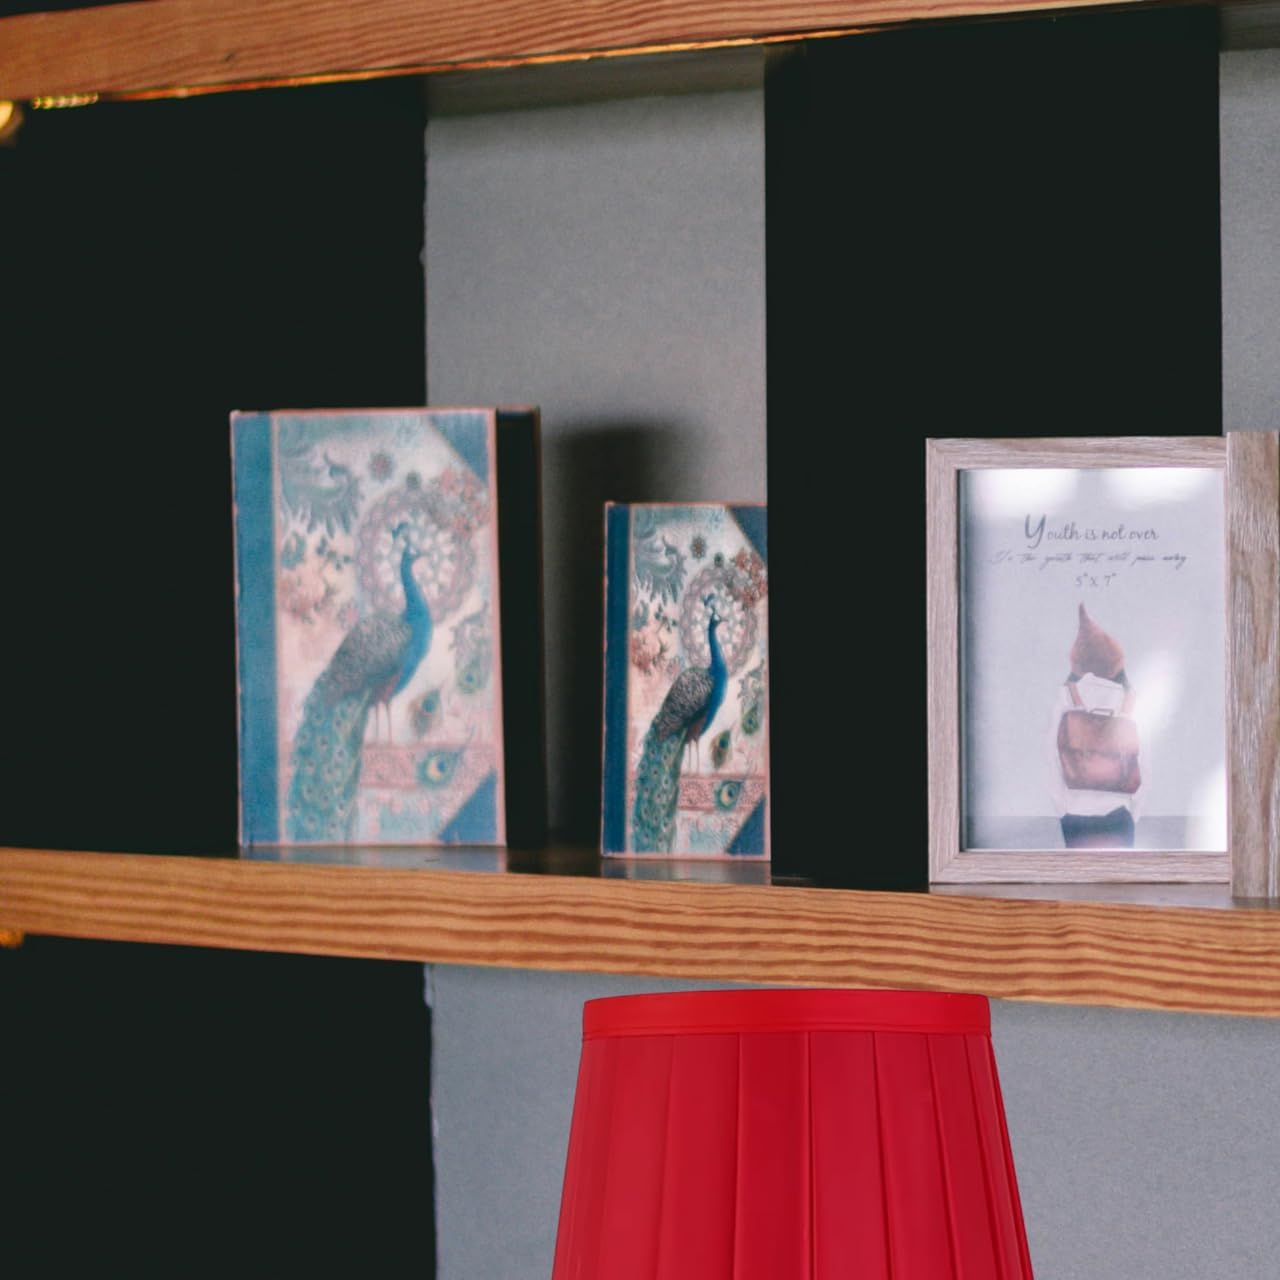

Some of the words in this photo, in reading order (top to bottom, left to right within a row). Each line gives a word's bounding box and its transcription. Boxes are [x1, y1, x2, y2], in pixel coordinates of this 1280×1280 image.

[1024, 513, 1081, 549] Youth
[1085, 527, 1098, 541] is
[1101, 524, 1127, 541] not
[1129, 530, 1160, 541] over
